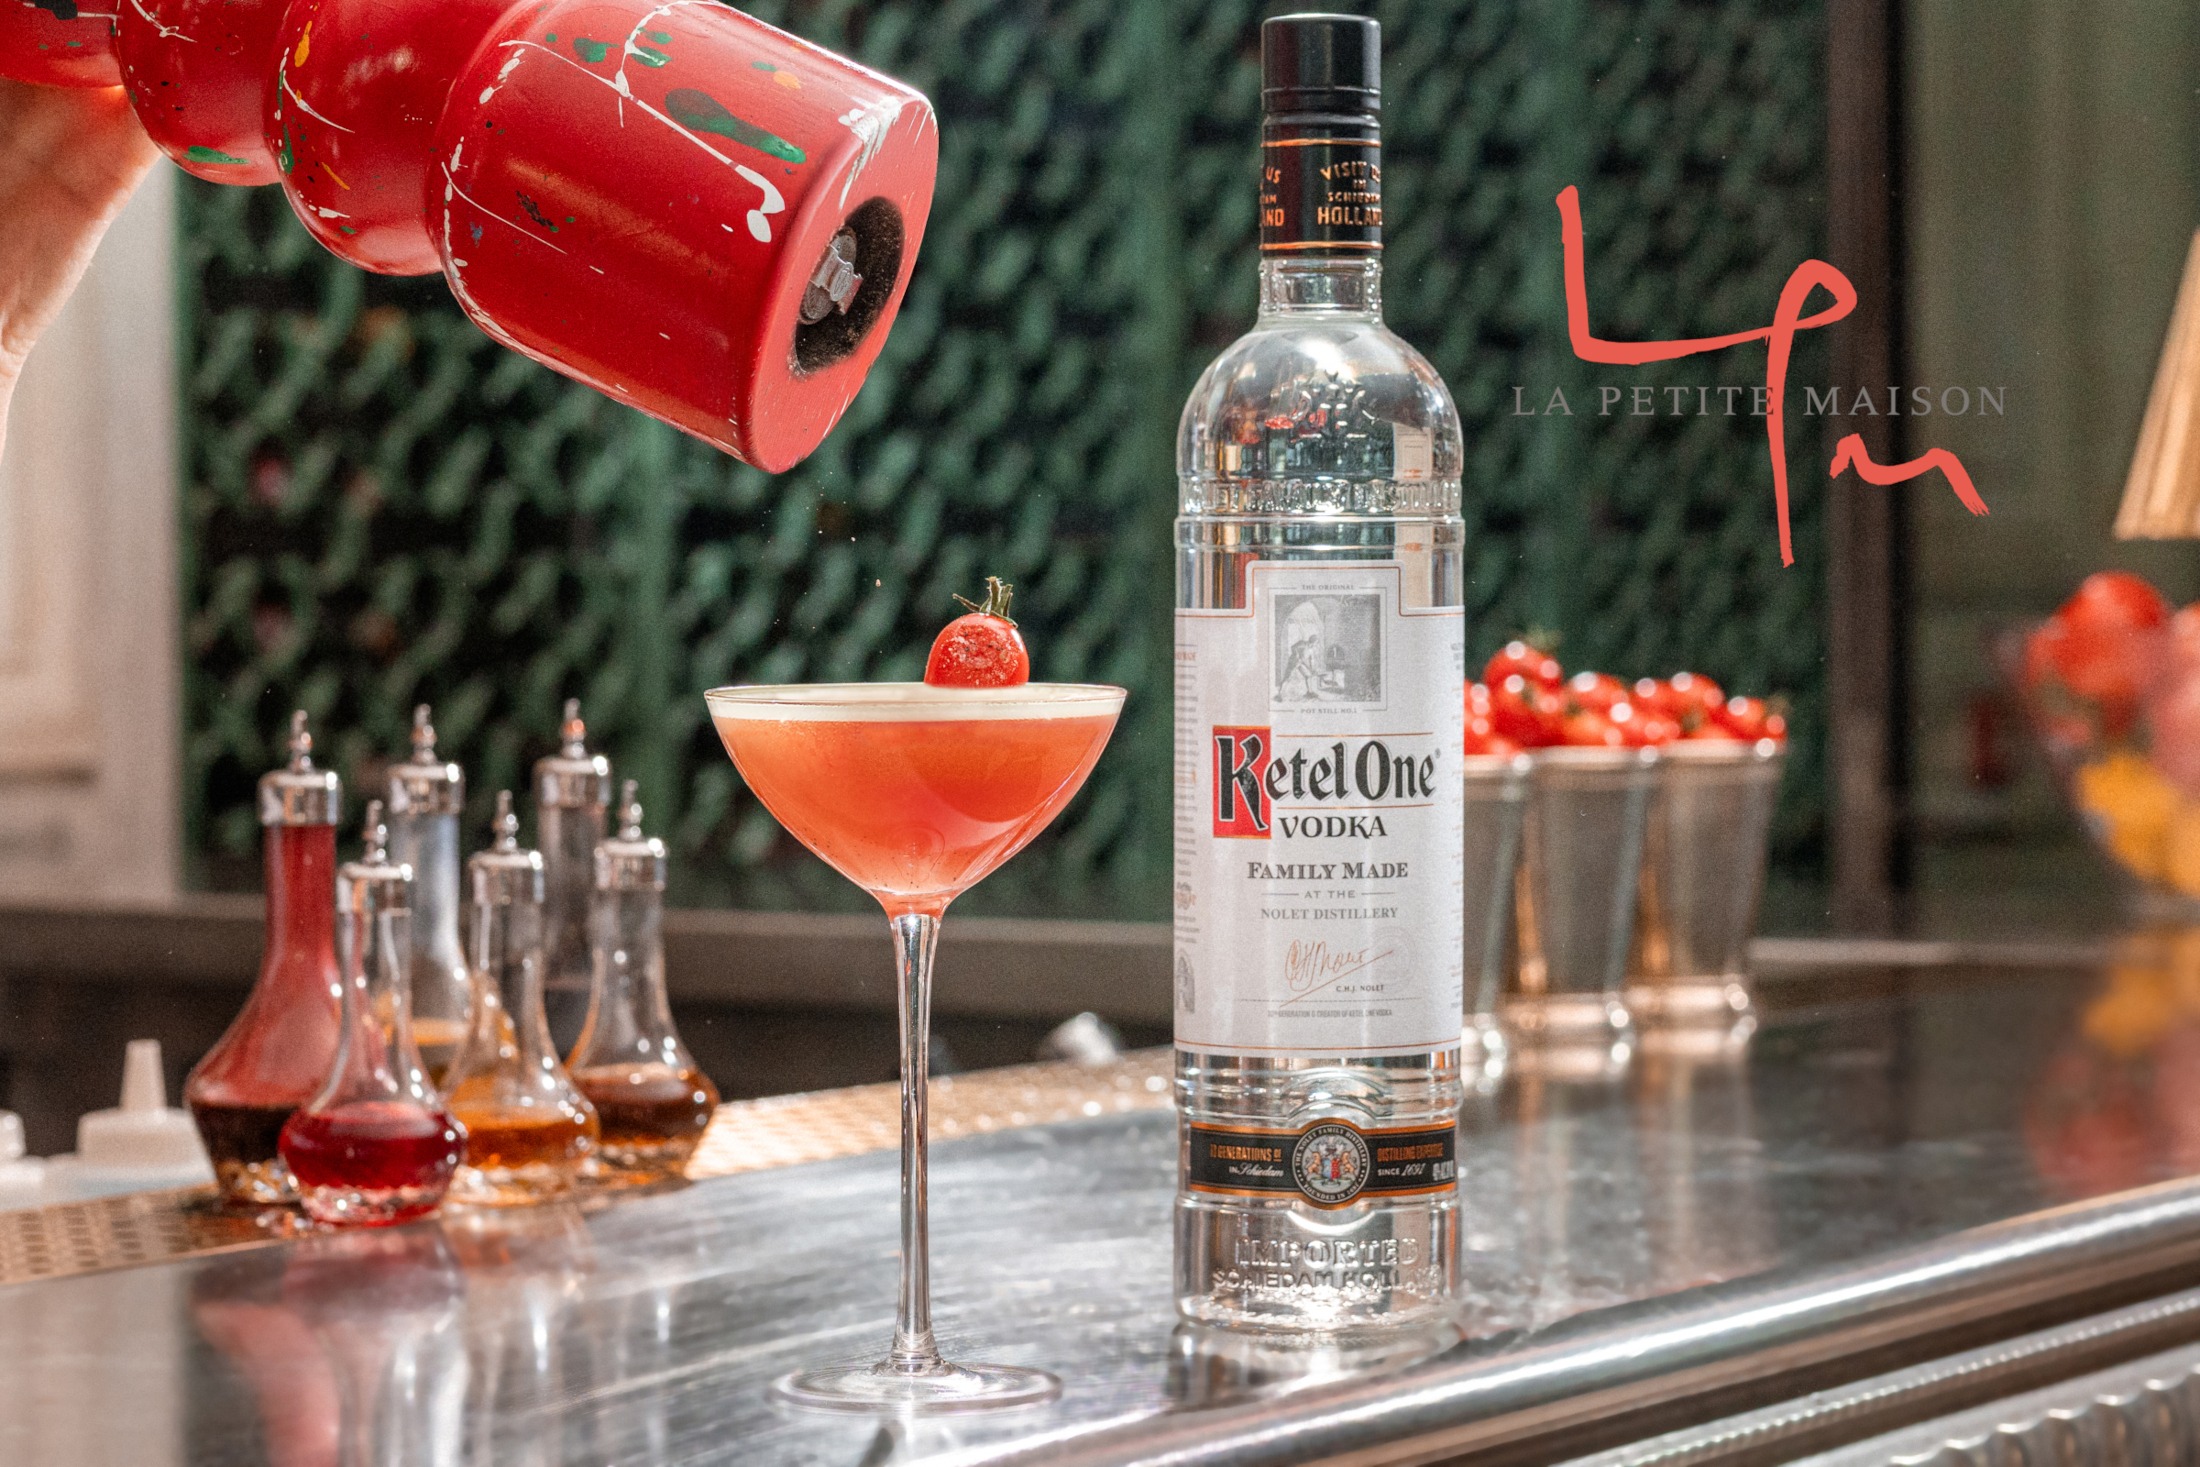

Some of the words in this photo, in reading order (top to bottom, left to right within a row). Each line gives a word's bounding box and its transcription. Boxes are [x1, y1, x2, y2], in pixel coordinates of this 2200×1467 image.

[1319, 161, 1367, 180] VISIT
[1317, 206, 1383, 226] HOLLAN
[1215, 734, 1349, 832] Ketel
[1355, 740, 1436, 801] One
[1278, 815, 1388, 839] VODKA
[1247, 861, 1336, 880] FAMILY
[1342, 862, 1409, 880] MADE
[1304, 890, 1322, 899] AT
[1328, 890, 1356, 899] THE
[1260, 908, 1310, 920] NOLET
[1313, 907, 1398, 920] DISTILLERY
[1360, 984, 1385, 993] NOLET
[1318, 1127, 1345, 1135] FAMILY
[1217, 1144, 1273, 1162] GENERATIONS
[1238, 1162, 1284, 1177] Schiedam
[1377, 1167, 1400, 1176] SINCE
[1401, 1163, 1426, 1177] 1691
[1234, 1237, 1419, 1269] IMPORTED
